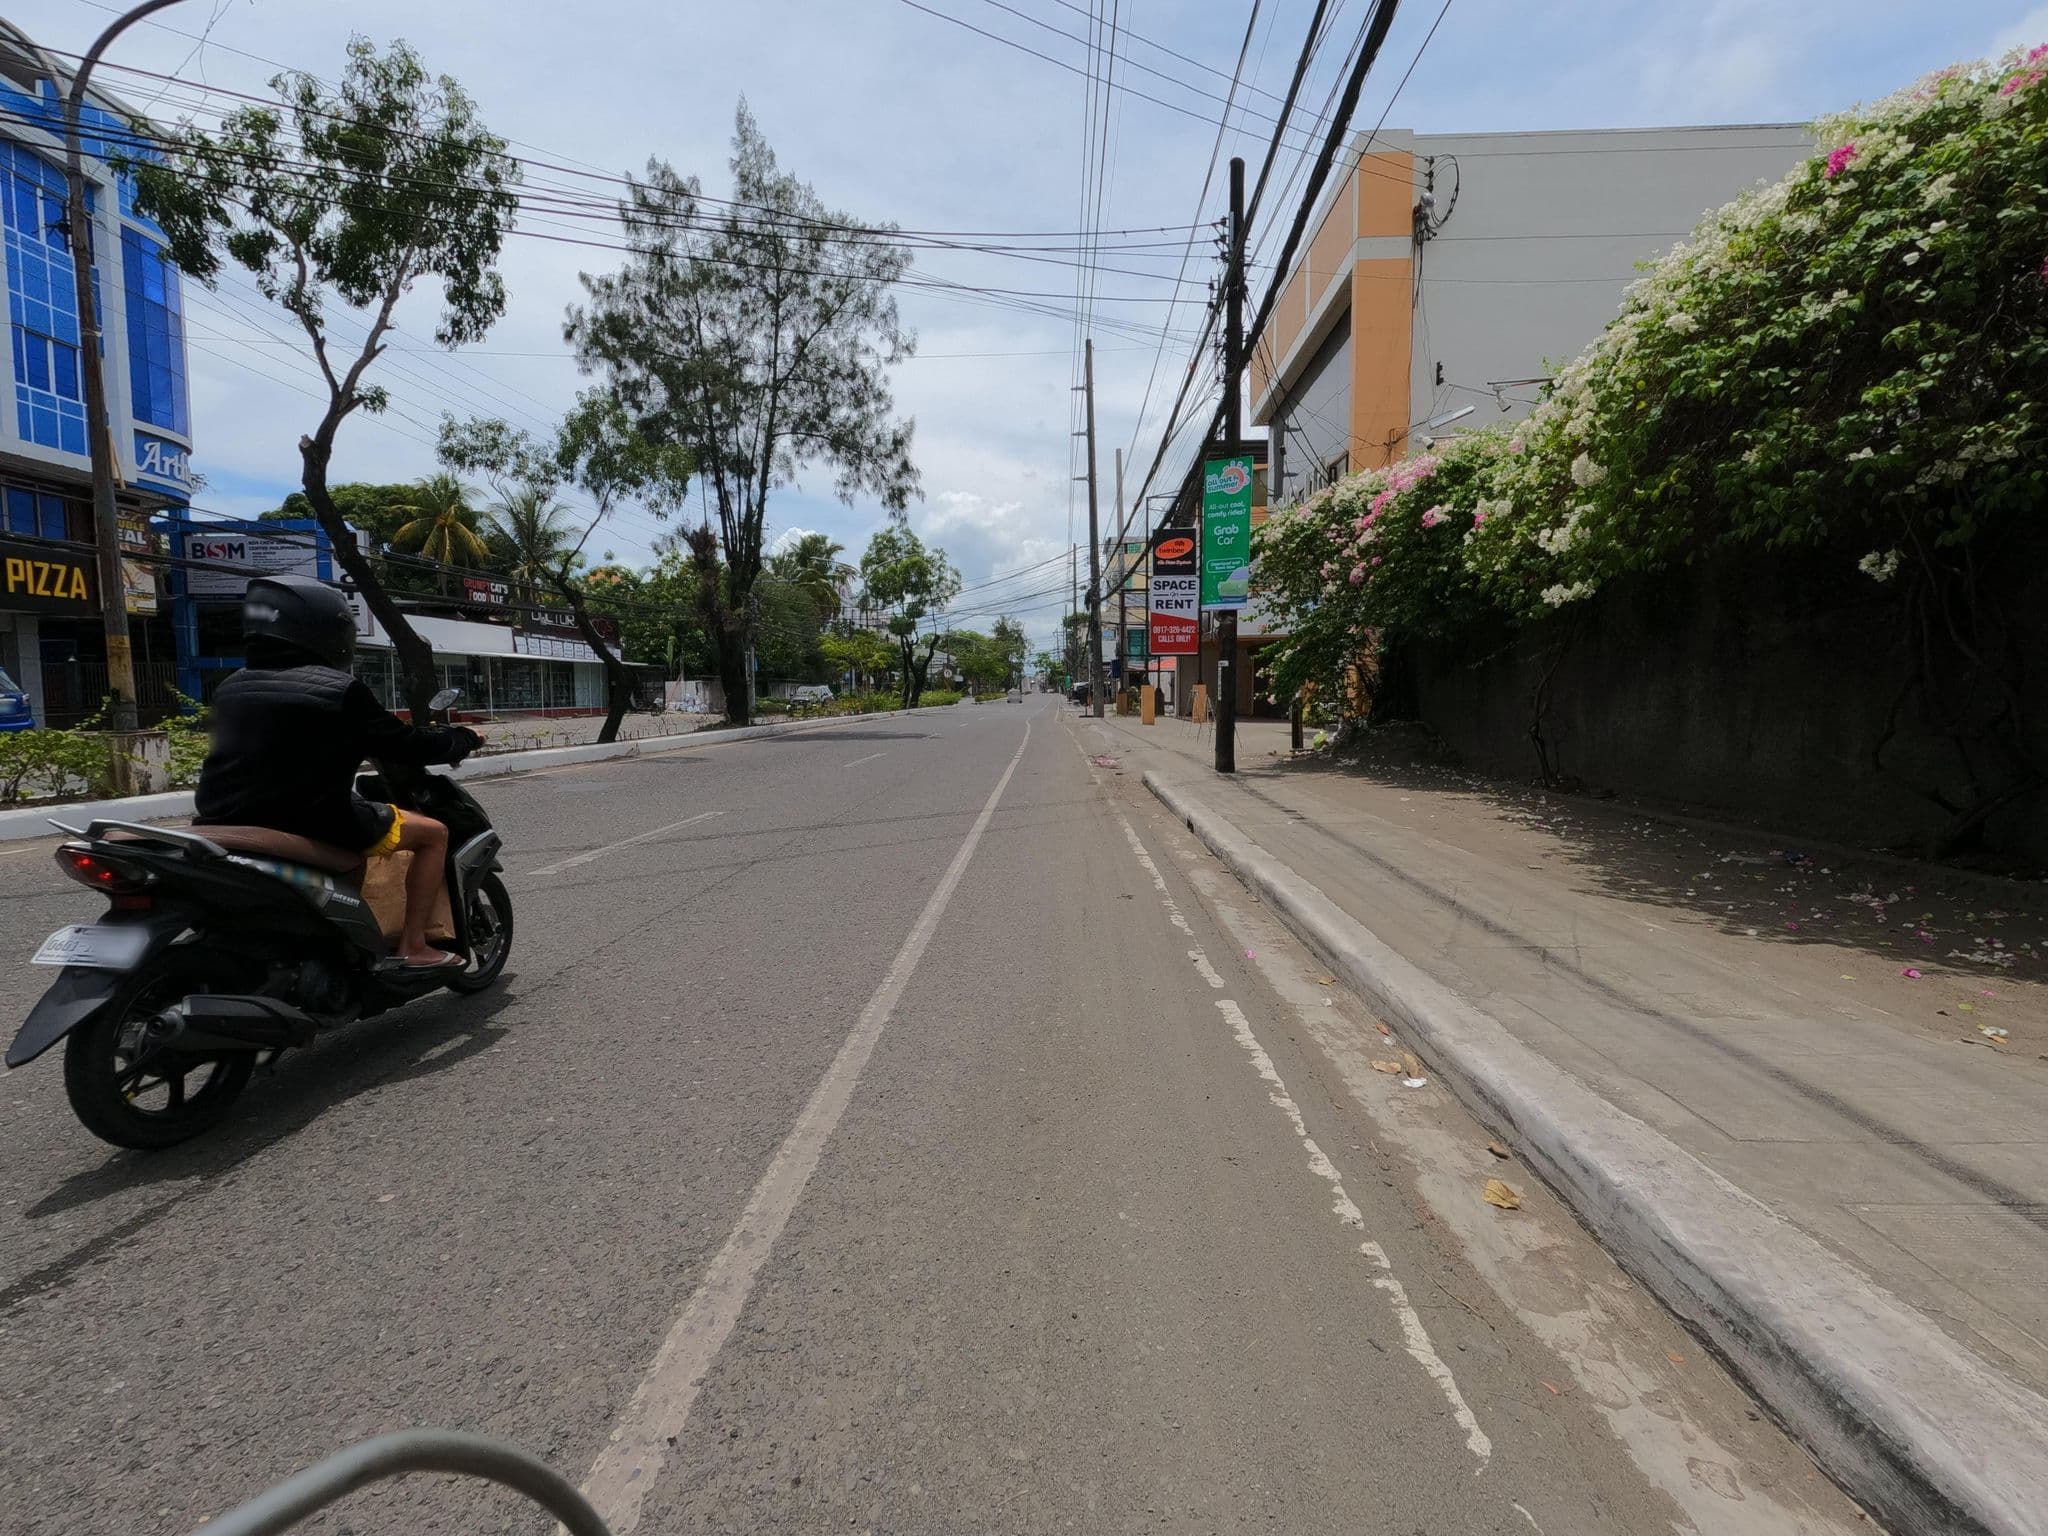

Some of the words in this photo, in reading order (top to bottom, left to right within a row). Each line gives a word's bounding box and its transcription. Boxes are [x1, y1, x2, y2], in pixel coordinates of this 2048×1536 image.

[1213, 523, 1239, 536] Grab
[1217, 536, 1235, 546] Car
[5, 557, 88, 600] PIZZA
[1153, 580, 1197, 591] SPACE
[1155, 599, 1194, 610] RENT
[1157, 635, 1175, 643] CALLS
